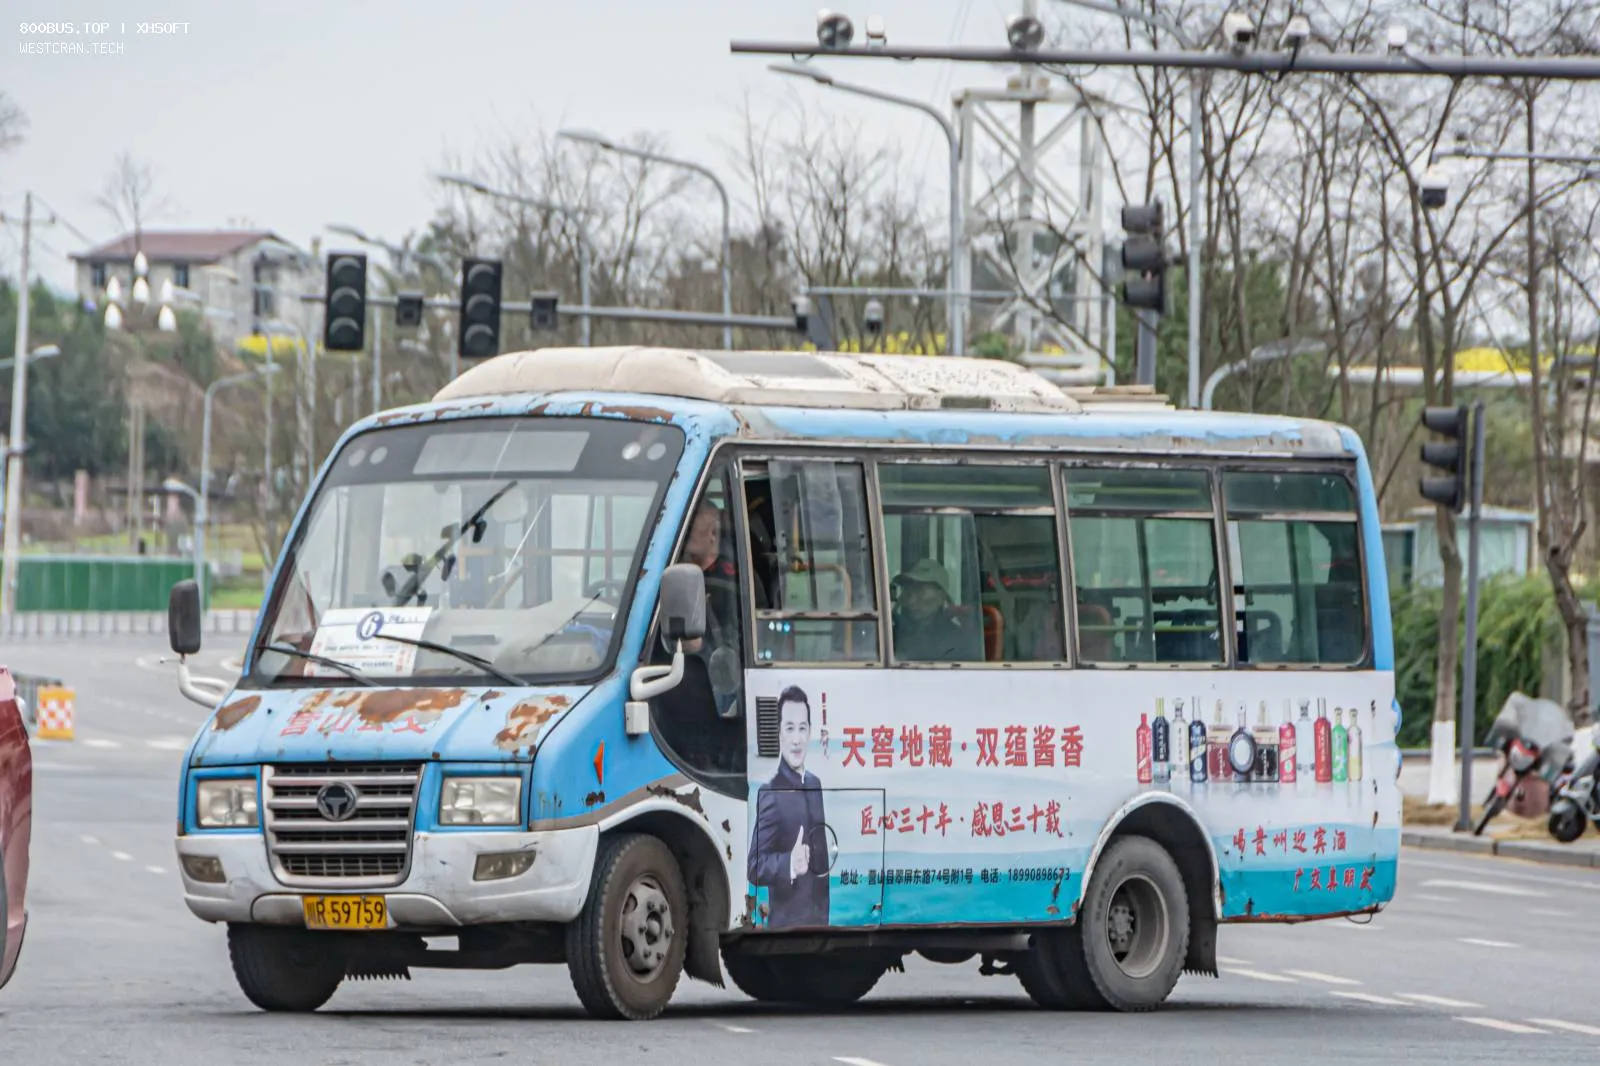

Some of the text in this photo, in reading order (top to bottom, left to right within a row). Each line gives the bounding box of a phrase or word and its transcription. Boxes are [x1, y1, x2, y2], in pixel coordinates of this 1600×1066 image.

[841, 724, 1084, 768] 天窖地藏·双蕴酱香
[860, 800, 1064, 838] 匠心三十年·感恩三十载
[1232, 824, 1347, 856] 喝贵州迎宾酒
